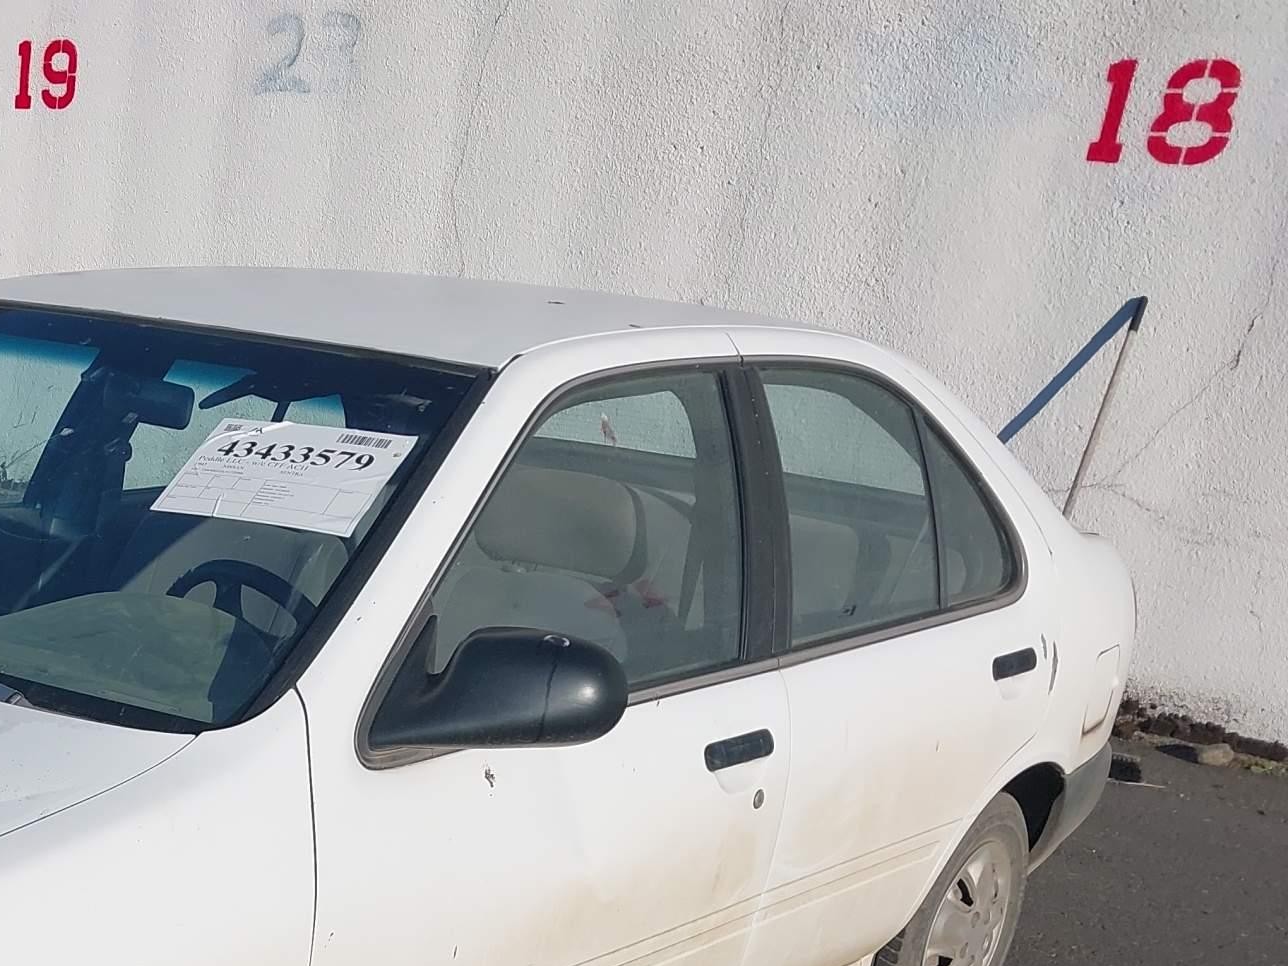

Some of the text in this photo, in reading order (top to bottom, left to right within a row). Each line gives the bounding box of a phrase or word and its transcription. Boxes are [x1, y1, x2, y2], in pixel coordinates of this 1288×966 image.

[13, 38, 78, 111] 19
[1085, 58, 1242, 167] 18
[216, 438, 376, 471] 43433579
